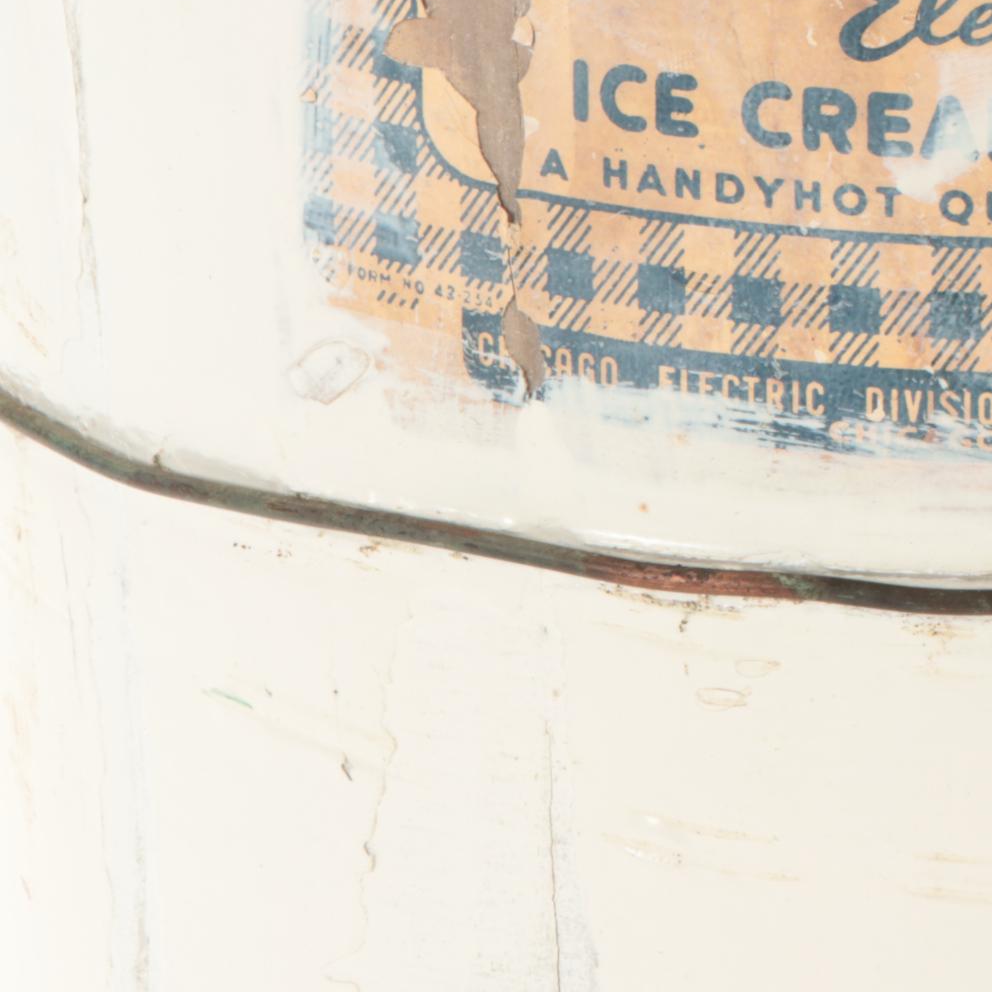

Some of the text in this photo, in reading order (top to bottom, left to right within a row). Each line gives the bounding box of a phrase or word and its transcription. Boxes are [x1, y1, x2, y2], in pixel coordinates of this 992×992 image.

[572, 58, 700, 139] ICE
[540, 148, 569, 181] A
[602, 156, 903, 218] HANDYHOT
[477, 330, 619, 389] CHCAGO
[657, 364, 827, 417] ELECTRIC
